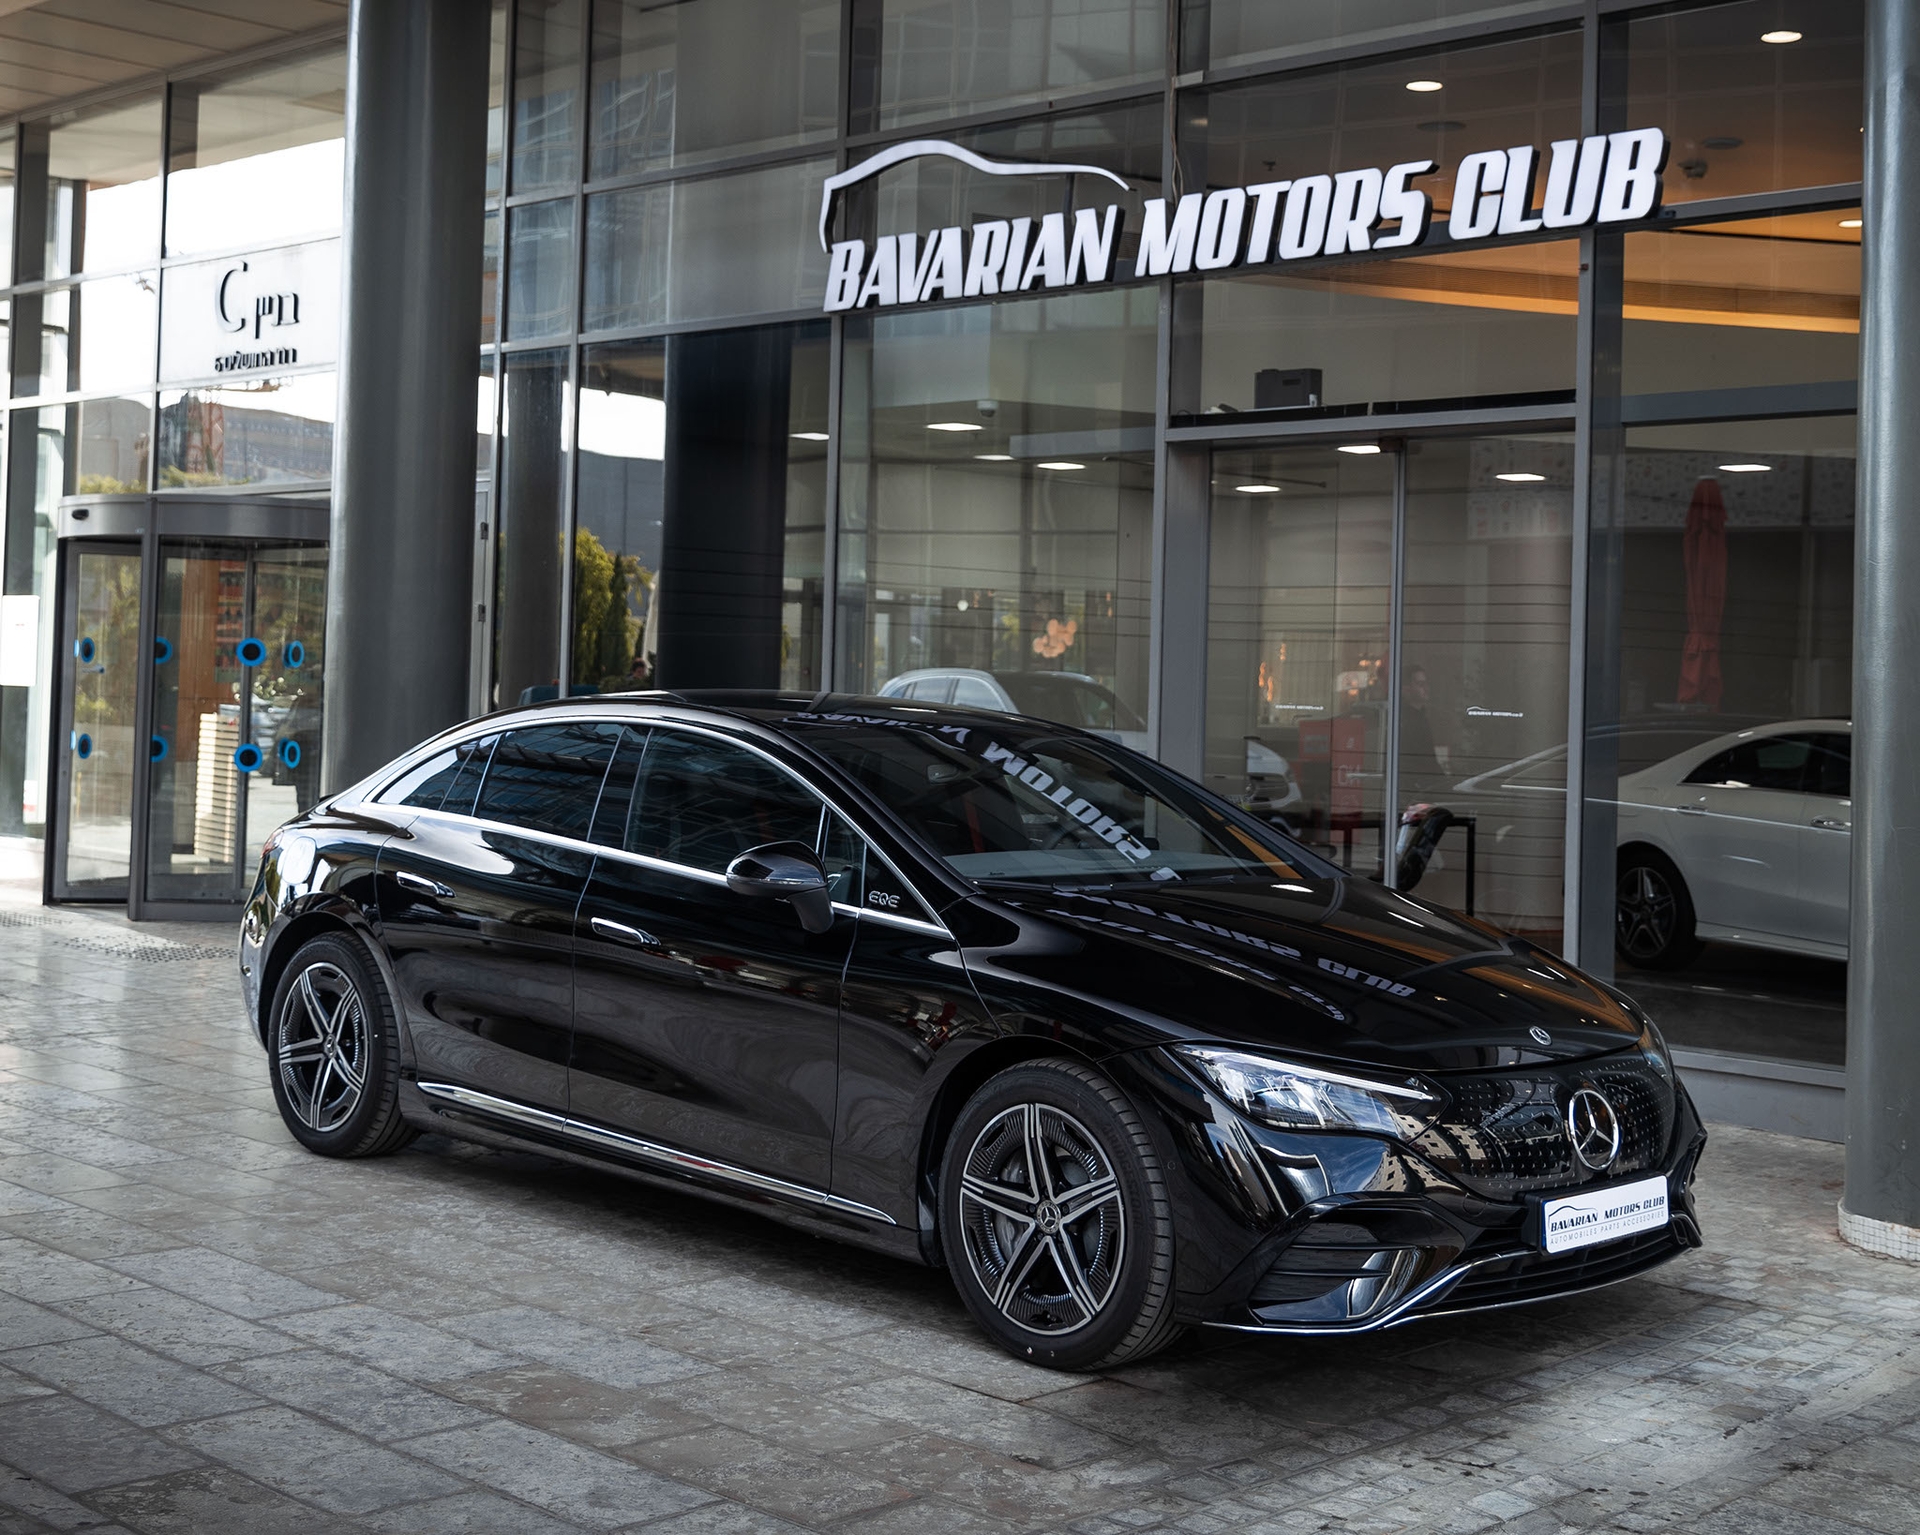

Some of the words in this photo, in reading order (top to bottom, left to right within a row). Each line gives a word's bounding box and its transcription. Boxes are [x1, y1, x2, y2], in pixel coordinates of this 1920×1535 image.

[823, 204, 1123, 312] BAVARIAN
[1134, 160, 1438, 276] MOTORS
[1448, 127, 1669, 241] CLUB
[868, 890, 901, 909] EQE
[1550, 1212, 1598, 1232] BAVARIAN
[1603, 1202, 1641, 1220] MOTORS
[1643, 1196, 1665, 1210] CLUB
[1550, 1228, 1598, 1245] AUTOMOBILES
[1601, 1223, 1620, 1233] PARTS
[1623, 1211, 1665, 1227] ACCESSORIES
